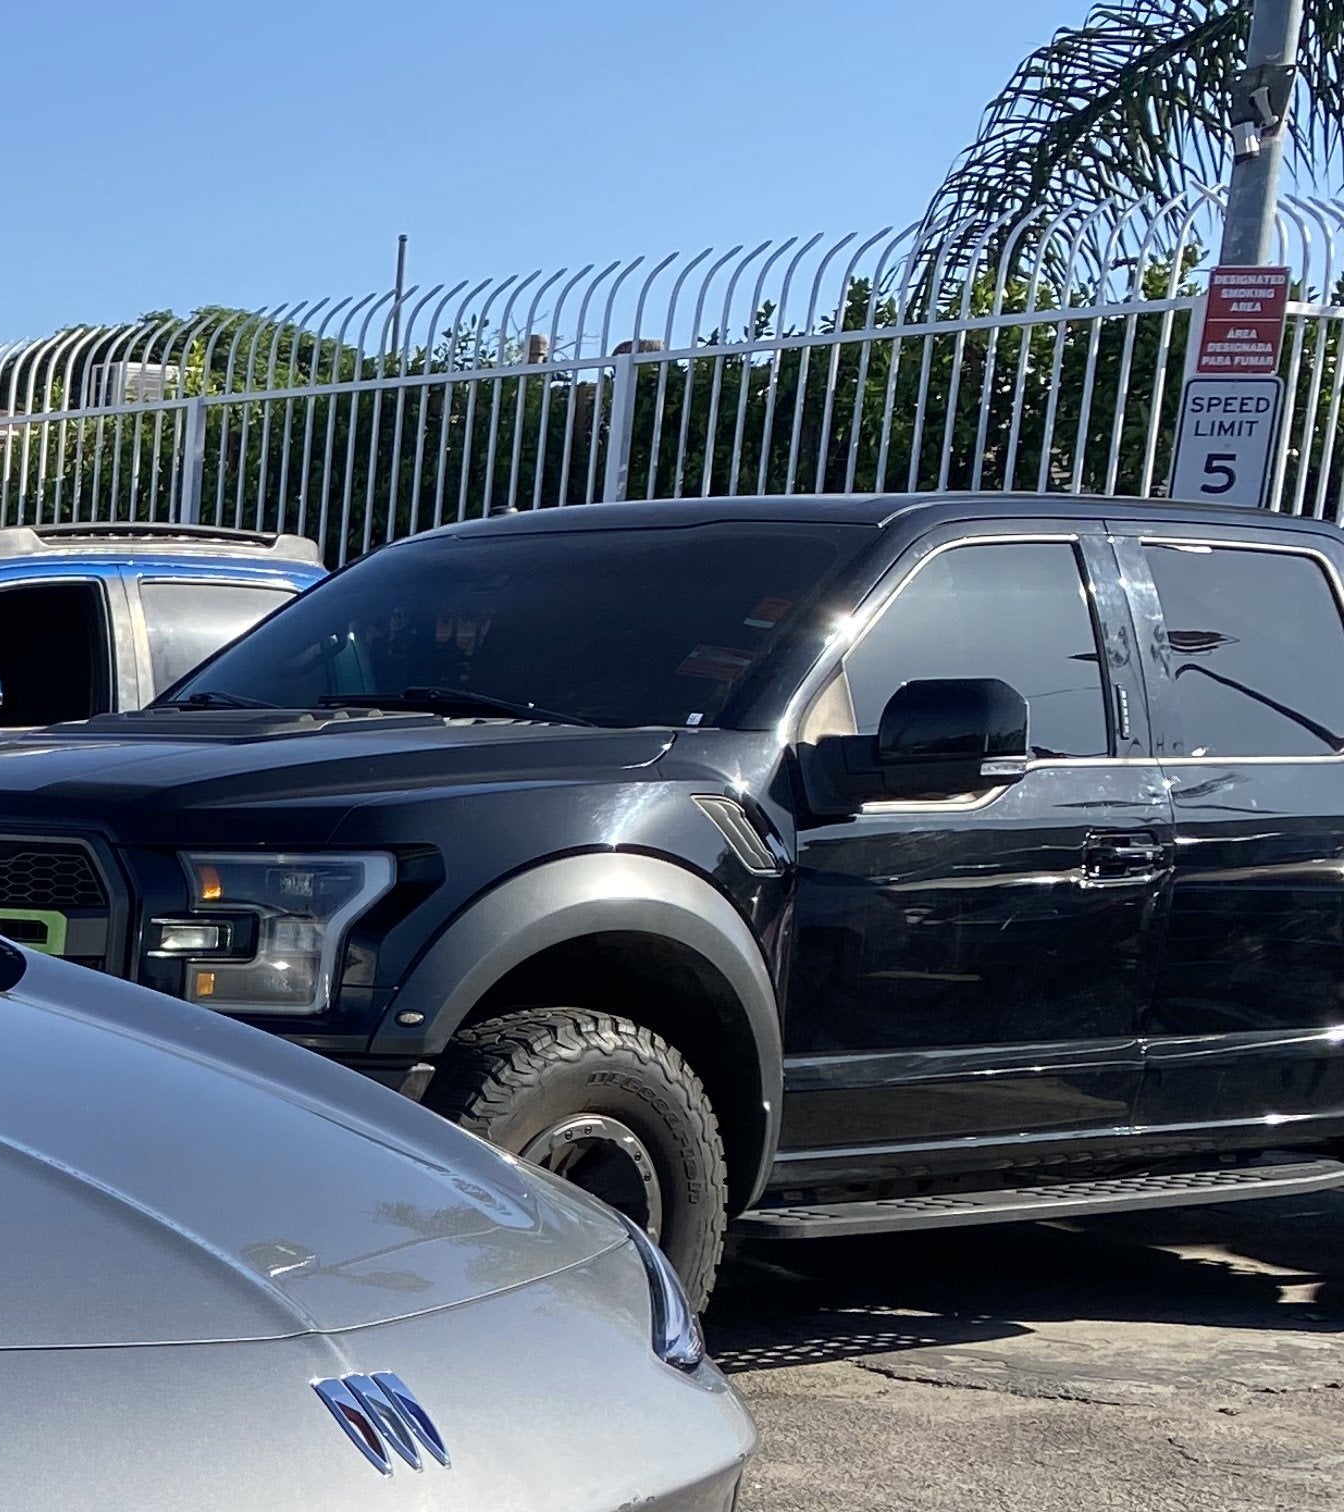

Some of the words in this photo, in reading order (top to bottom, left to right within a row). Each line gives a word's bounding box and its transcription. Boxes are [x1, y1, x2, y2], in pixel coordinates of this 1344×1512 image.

[1230, 301, 1262, 312] AREA
[1201, 355, 1231, 366] PARA
[1234, 355, 1274, 366] FUMAR
[1190, 396, 1270, 414] SPEED
[1194, 420, 1259, 437] LIMIT
[1200, 453, 1236, 494] 5
